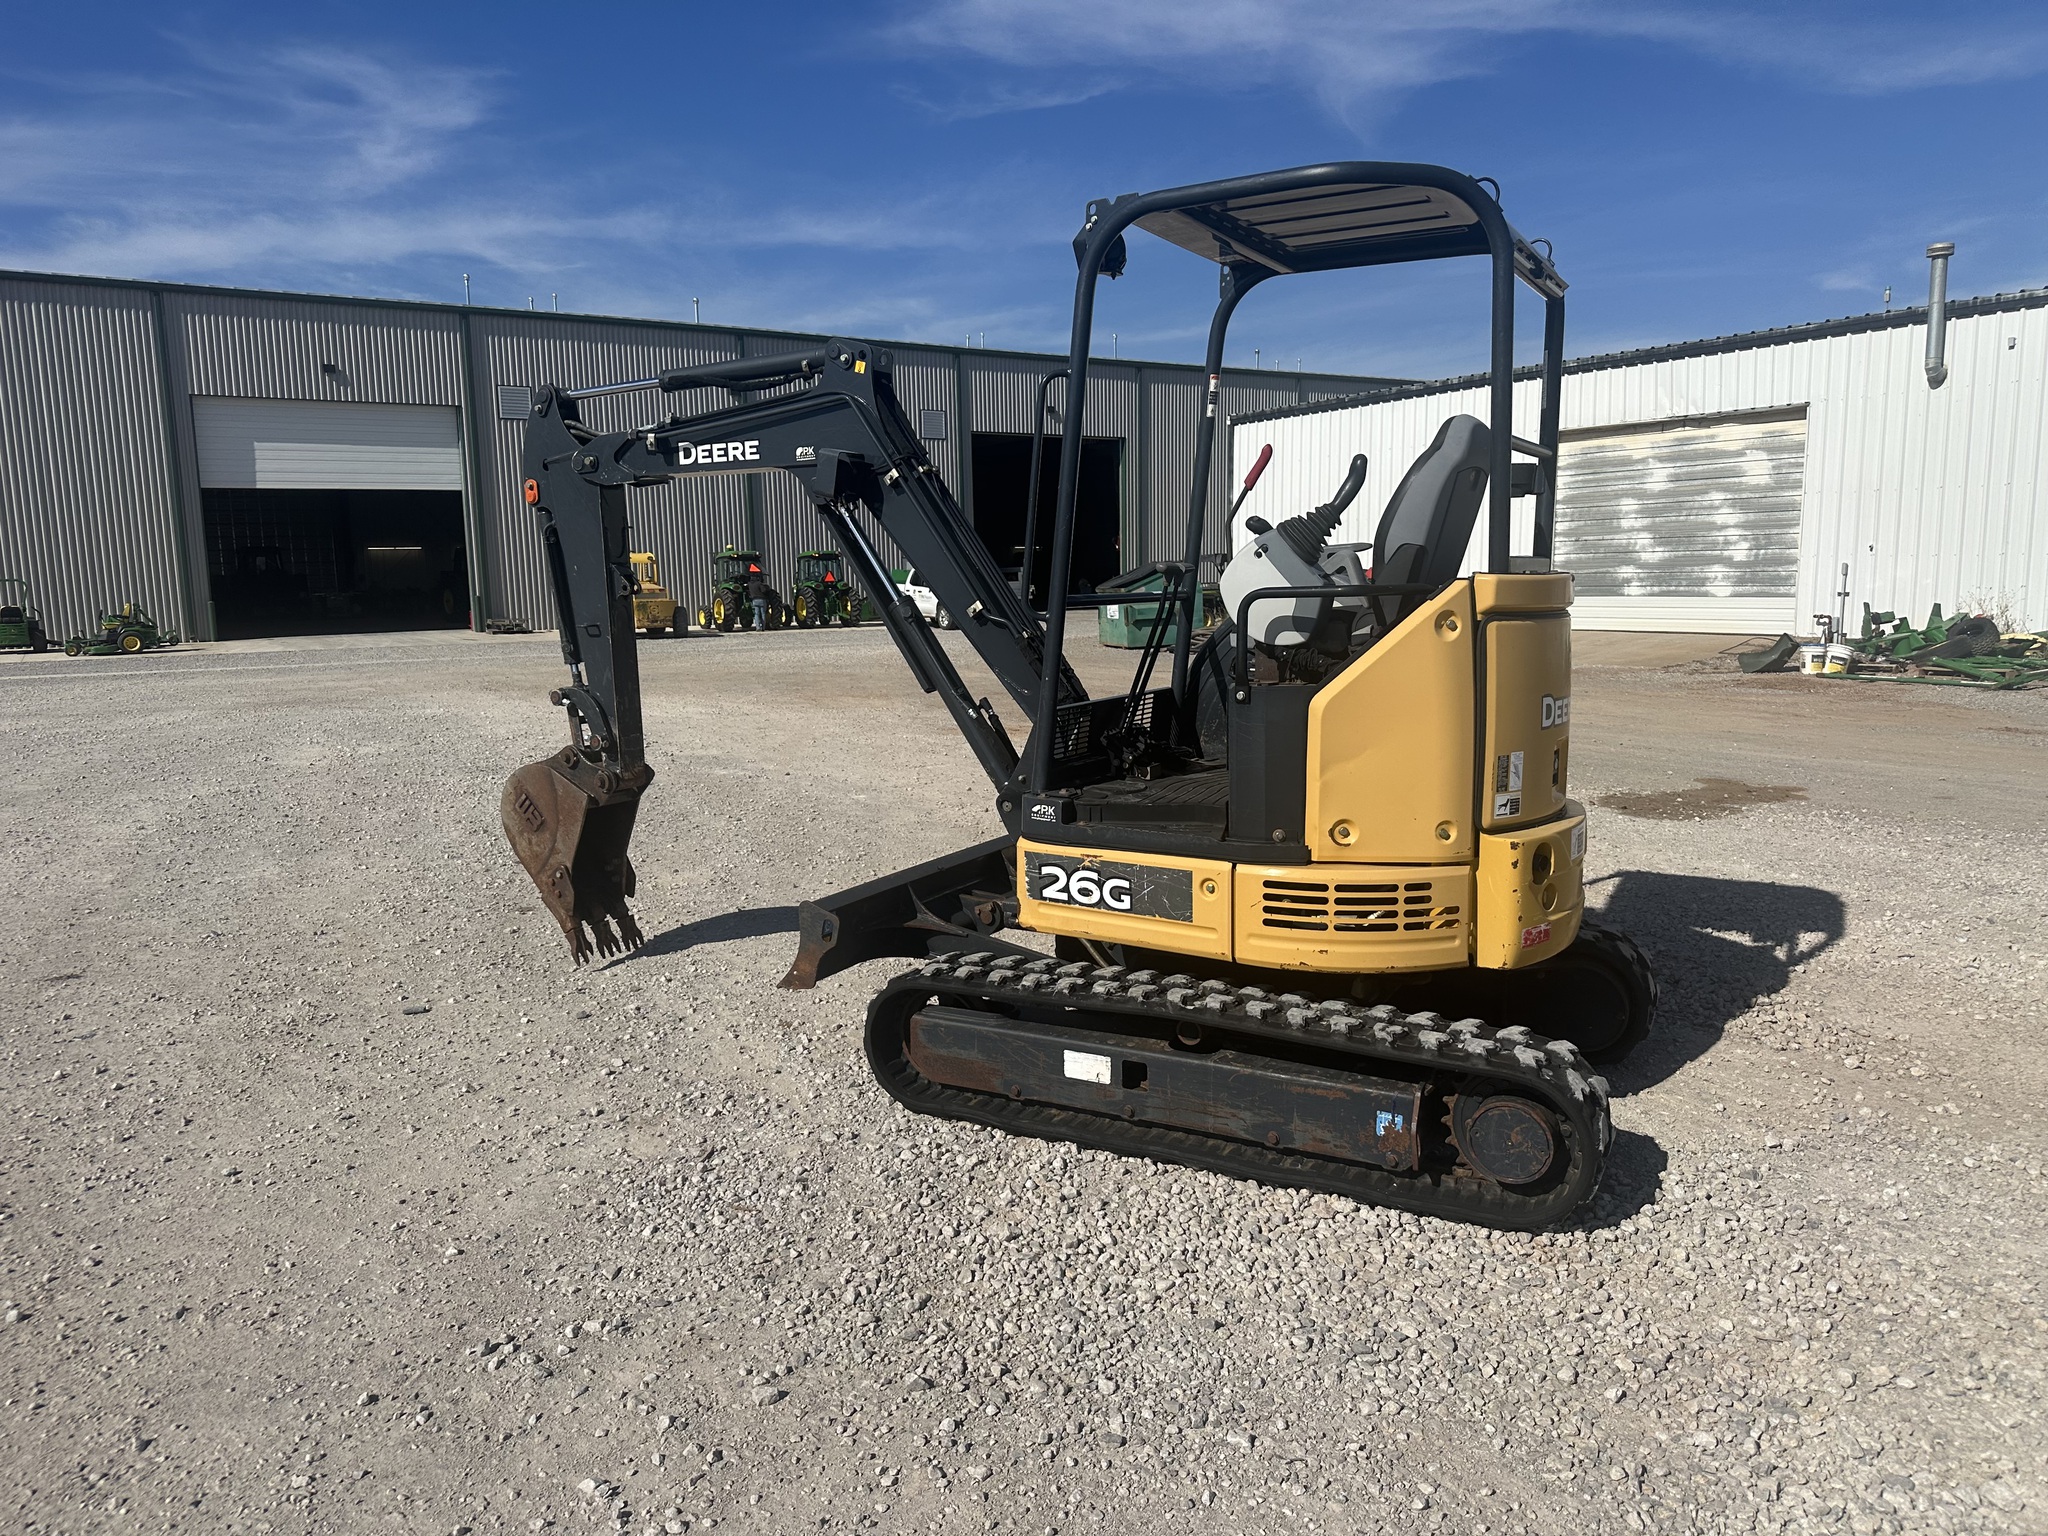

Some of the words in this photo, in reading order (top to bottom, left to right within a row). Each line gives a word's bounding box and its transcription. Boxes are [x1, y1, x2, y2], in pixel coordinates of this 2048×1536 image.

[678, 440, 760, 465] DEERE
[1541, 696, 1570, 728] DEE
[1041, 866, 1131, 910] 26G
